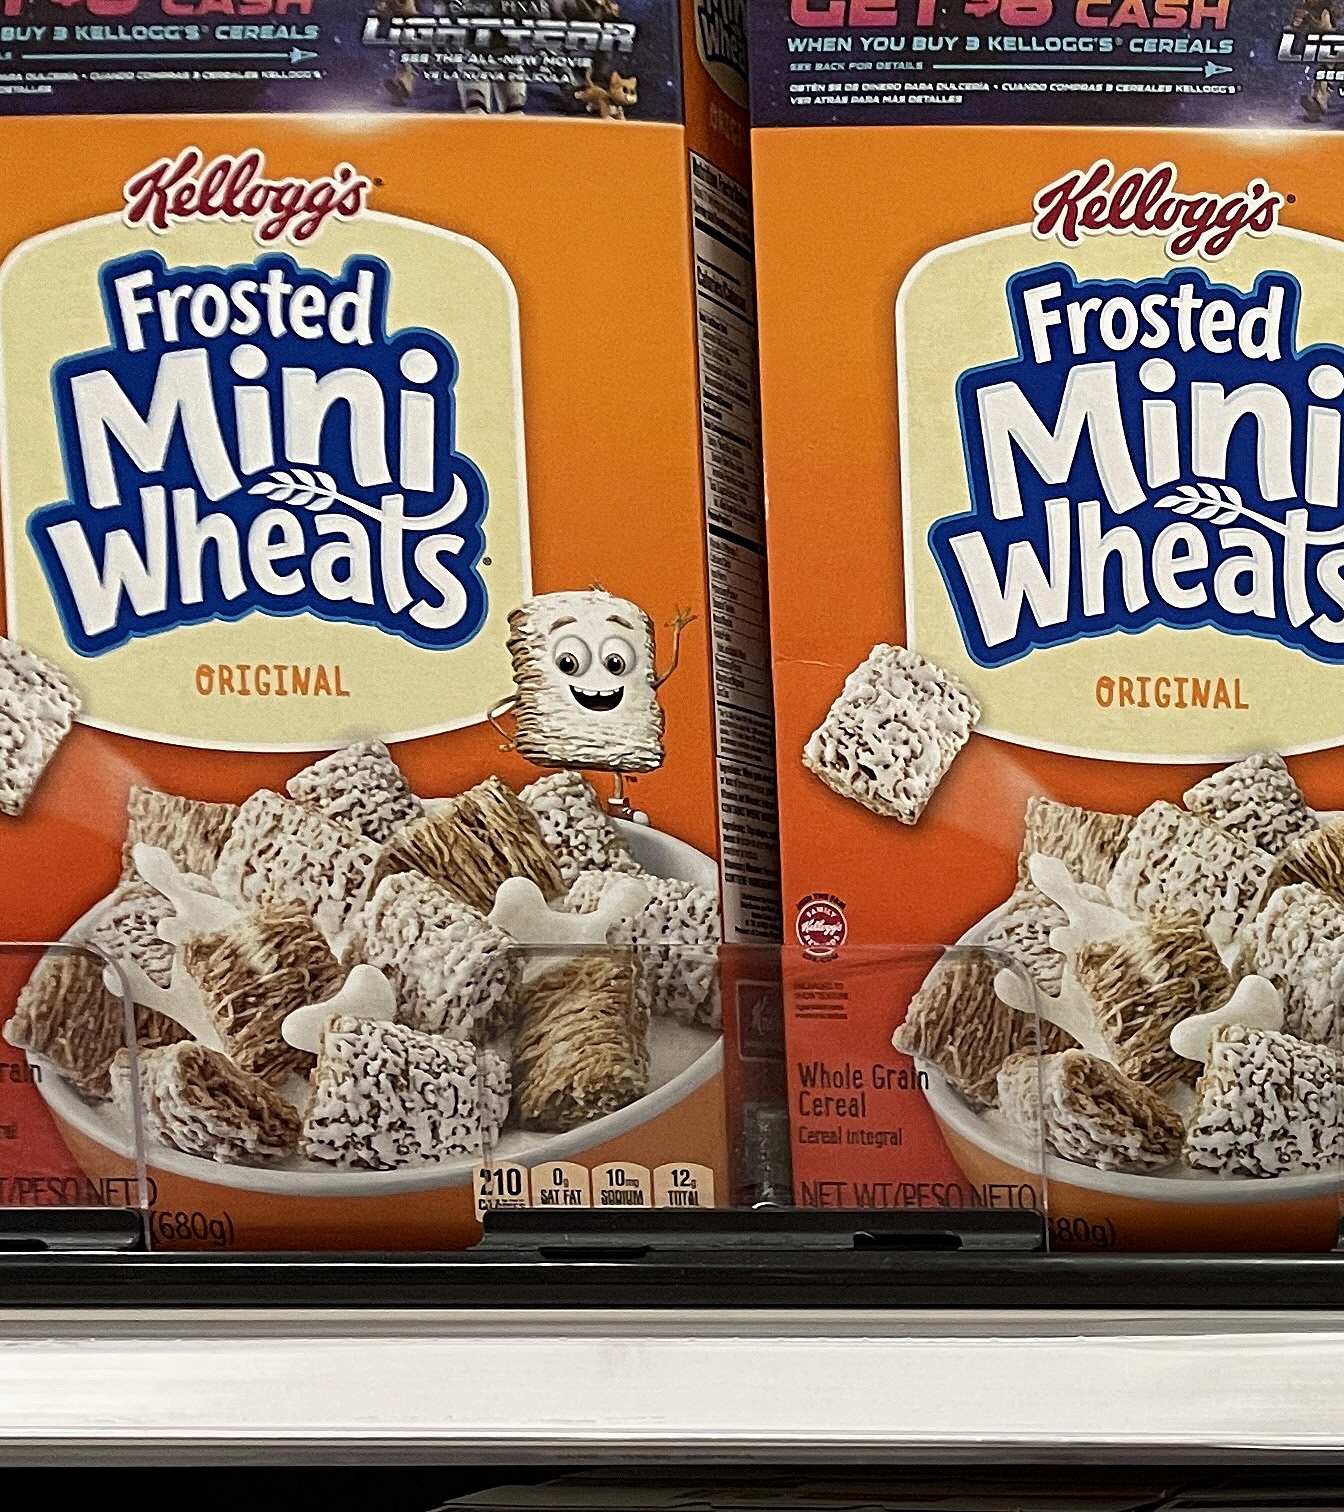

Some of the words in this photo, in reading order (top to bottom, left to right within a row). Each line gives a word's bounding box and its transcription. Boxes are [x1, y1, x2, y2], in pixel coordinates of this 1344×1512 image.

[788, 37, 852, 53] WHEN
[860, 37, 904, 54] YOU
[913, 37, 958, 54] BUY
[965, 38, 977, 54] 3
[989, 37, 1112, 55] KELLOGG'S
[1129, 38, 1233, 55] CEREALS
[128, 152, 364, 240] Kellogg's
[1036, 163, 1278, 255] Kellogg's
[115, 270, 372, 350] Frosted
[1023, 282, 1283, 362] Frosted
[72, 346, 437, 509] Mini
[977, 361, 1344, 519] Mini
[48, 474, 468, 635] Wheats
[196, 665, 350, 698] ORIGINAL
[1096, 676, 1249, 709] ORIGINAL
[800, 1062, 863, 1090] Whole
[873, 1062, 929, 1090] Grain
[800, 1092, 866, 1118] Cereal
